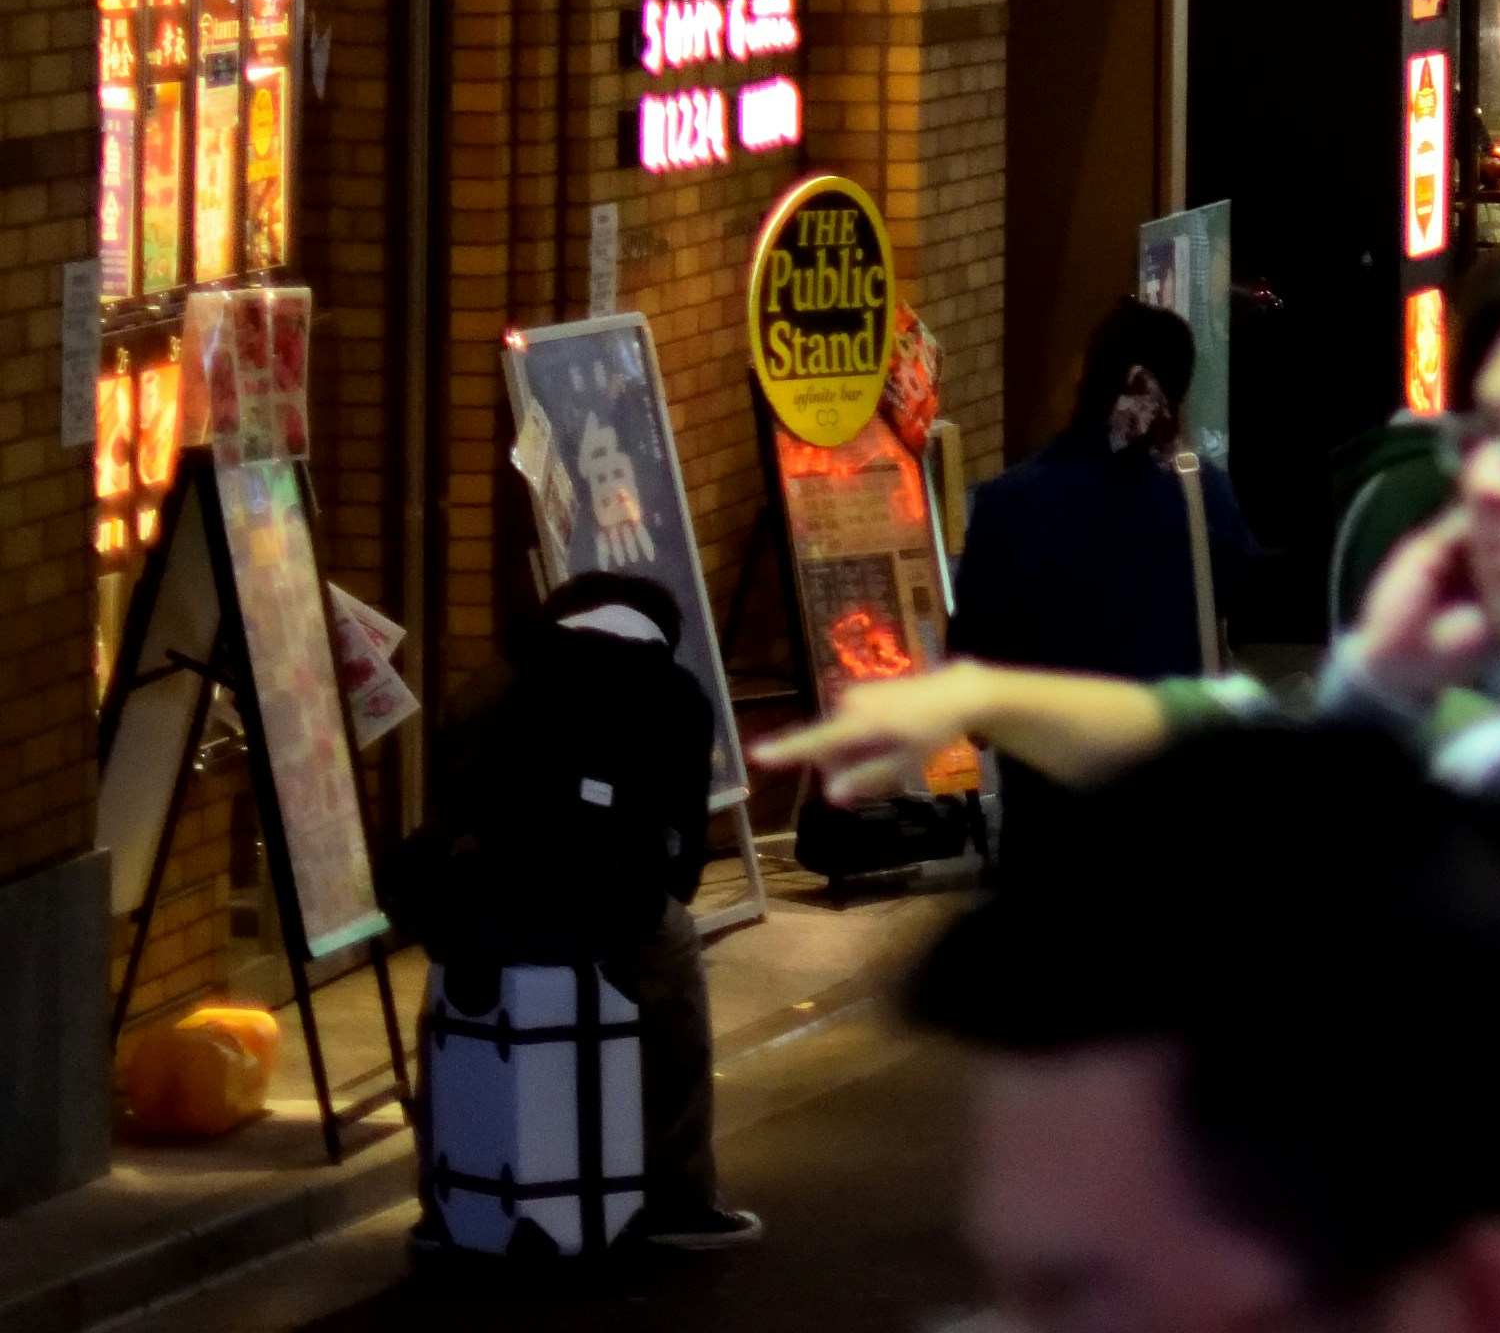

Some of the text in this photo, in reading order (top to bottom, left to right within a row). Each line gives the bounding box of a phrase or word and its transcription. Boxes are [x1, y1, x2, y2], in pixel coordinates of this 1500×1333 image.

[799, 208, 859, 245] THE
[768, 248, 885, 312] Public
[769, 319, 877, 381] Stand
